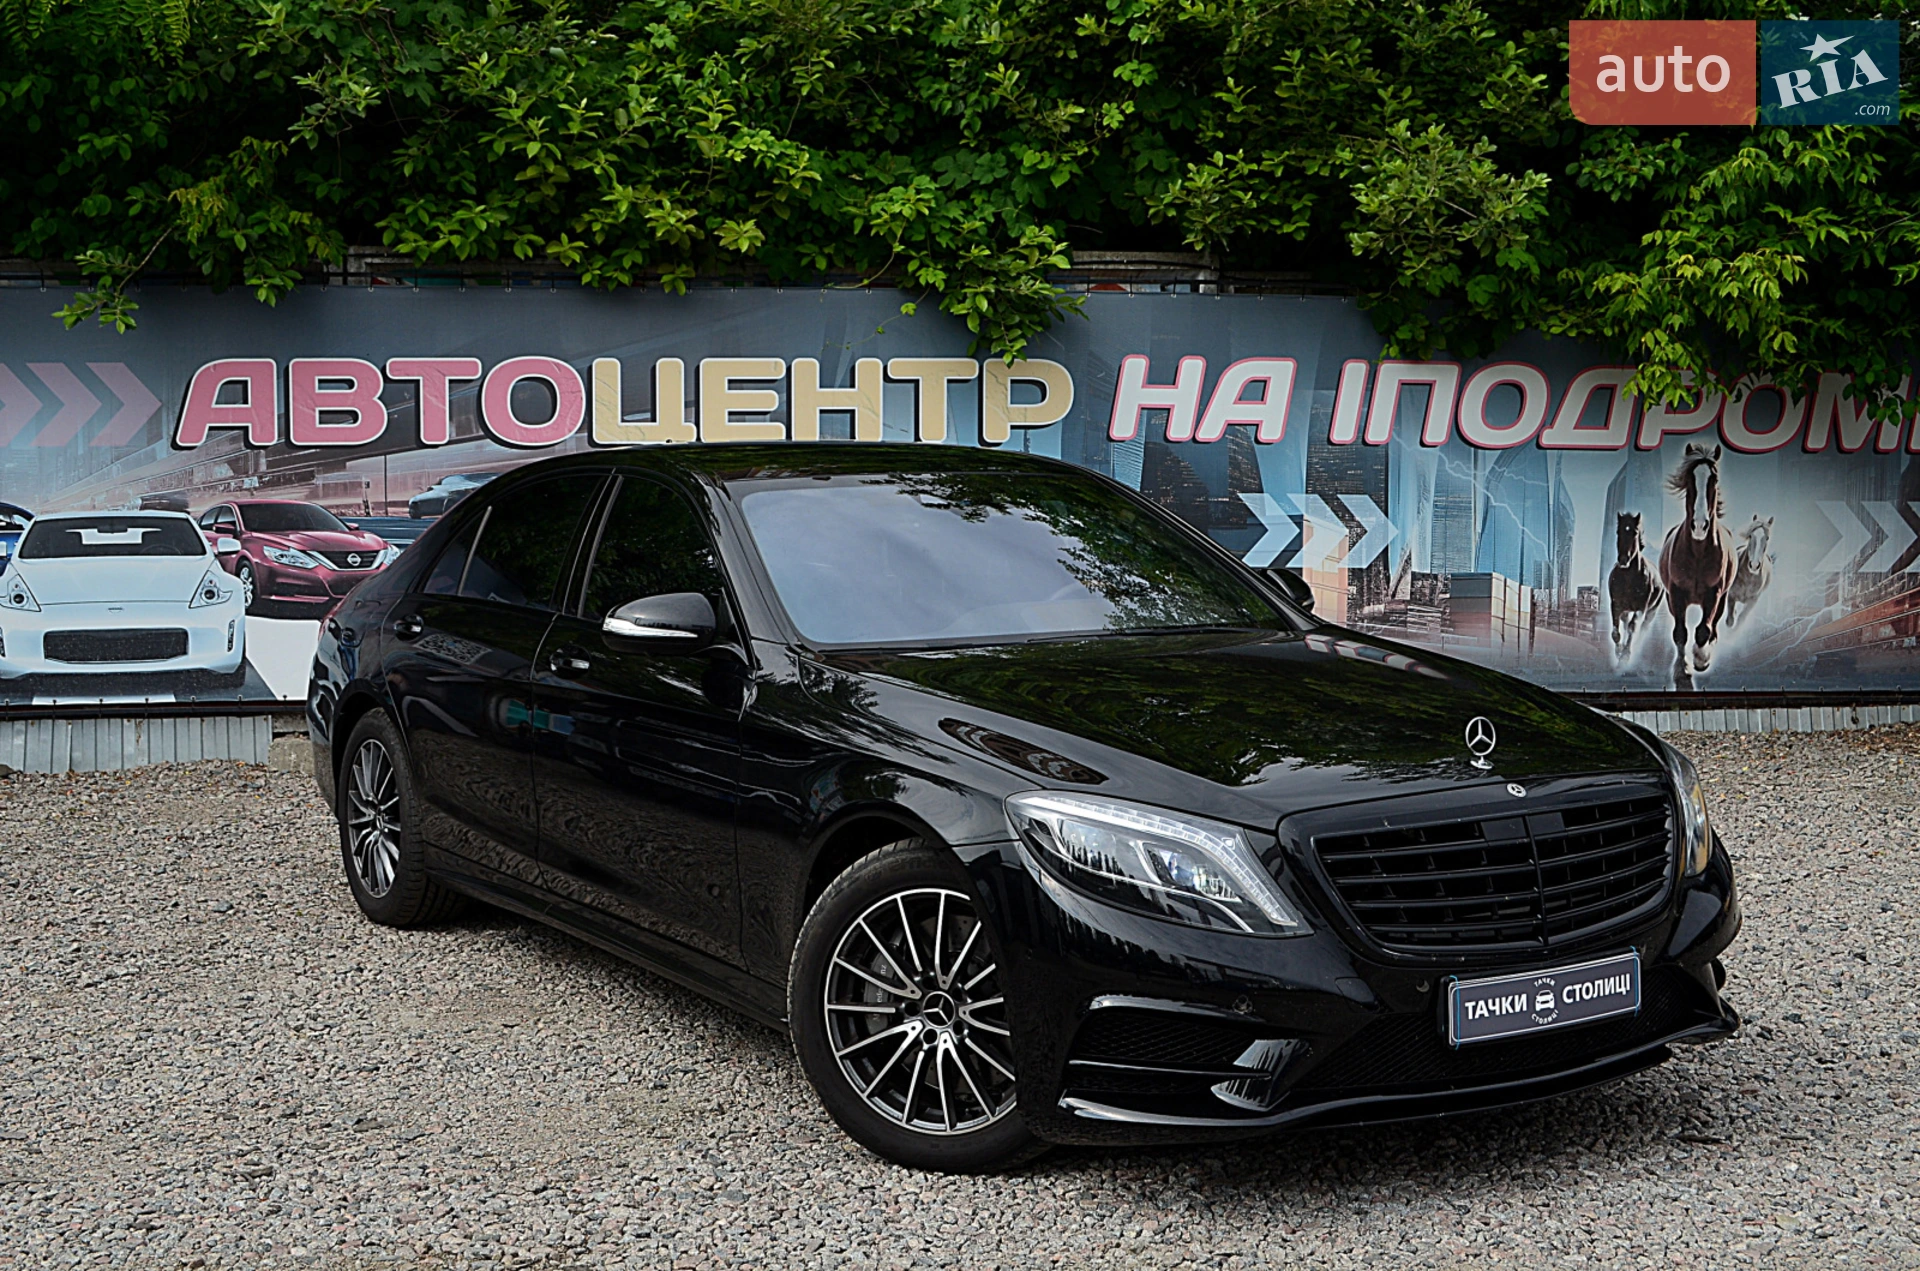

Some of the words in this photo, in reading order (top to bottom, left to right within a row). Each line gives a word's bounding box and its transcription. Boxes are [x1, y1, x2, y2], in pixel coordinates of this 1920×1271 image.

[175, 355, 1075, 447] АВТОЦЕНТР
[1108, 354, 1298, 444] НА
[1329, 357, 1920, 455] ІПОДРОМ
[1465, 993, 1528, 1020] ТАЧКИ
[1562, 973, 1631, 1004] СТОЛИЦІ
